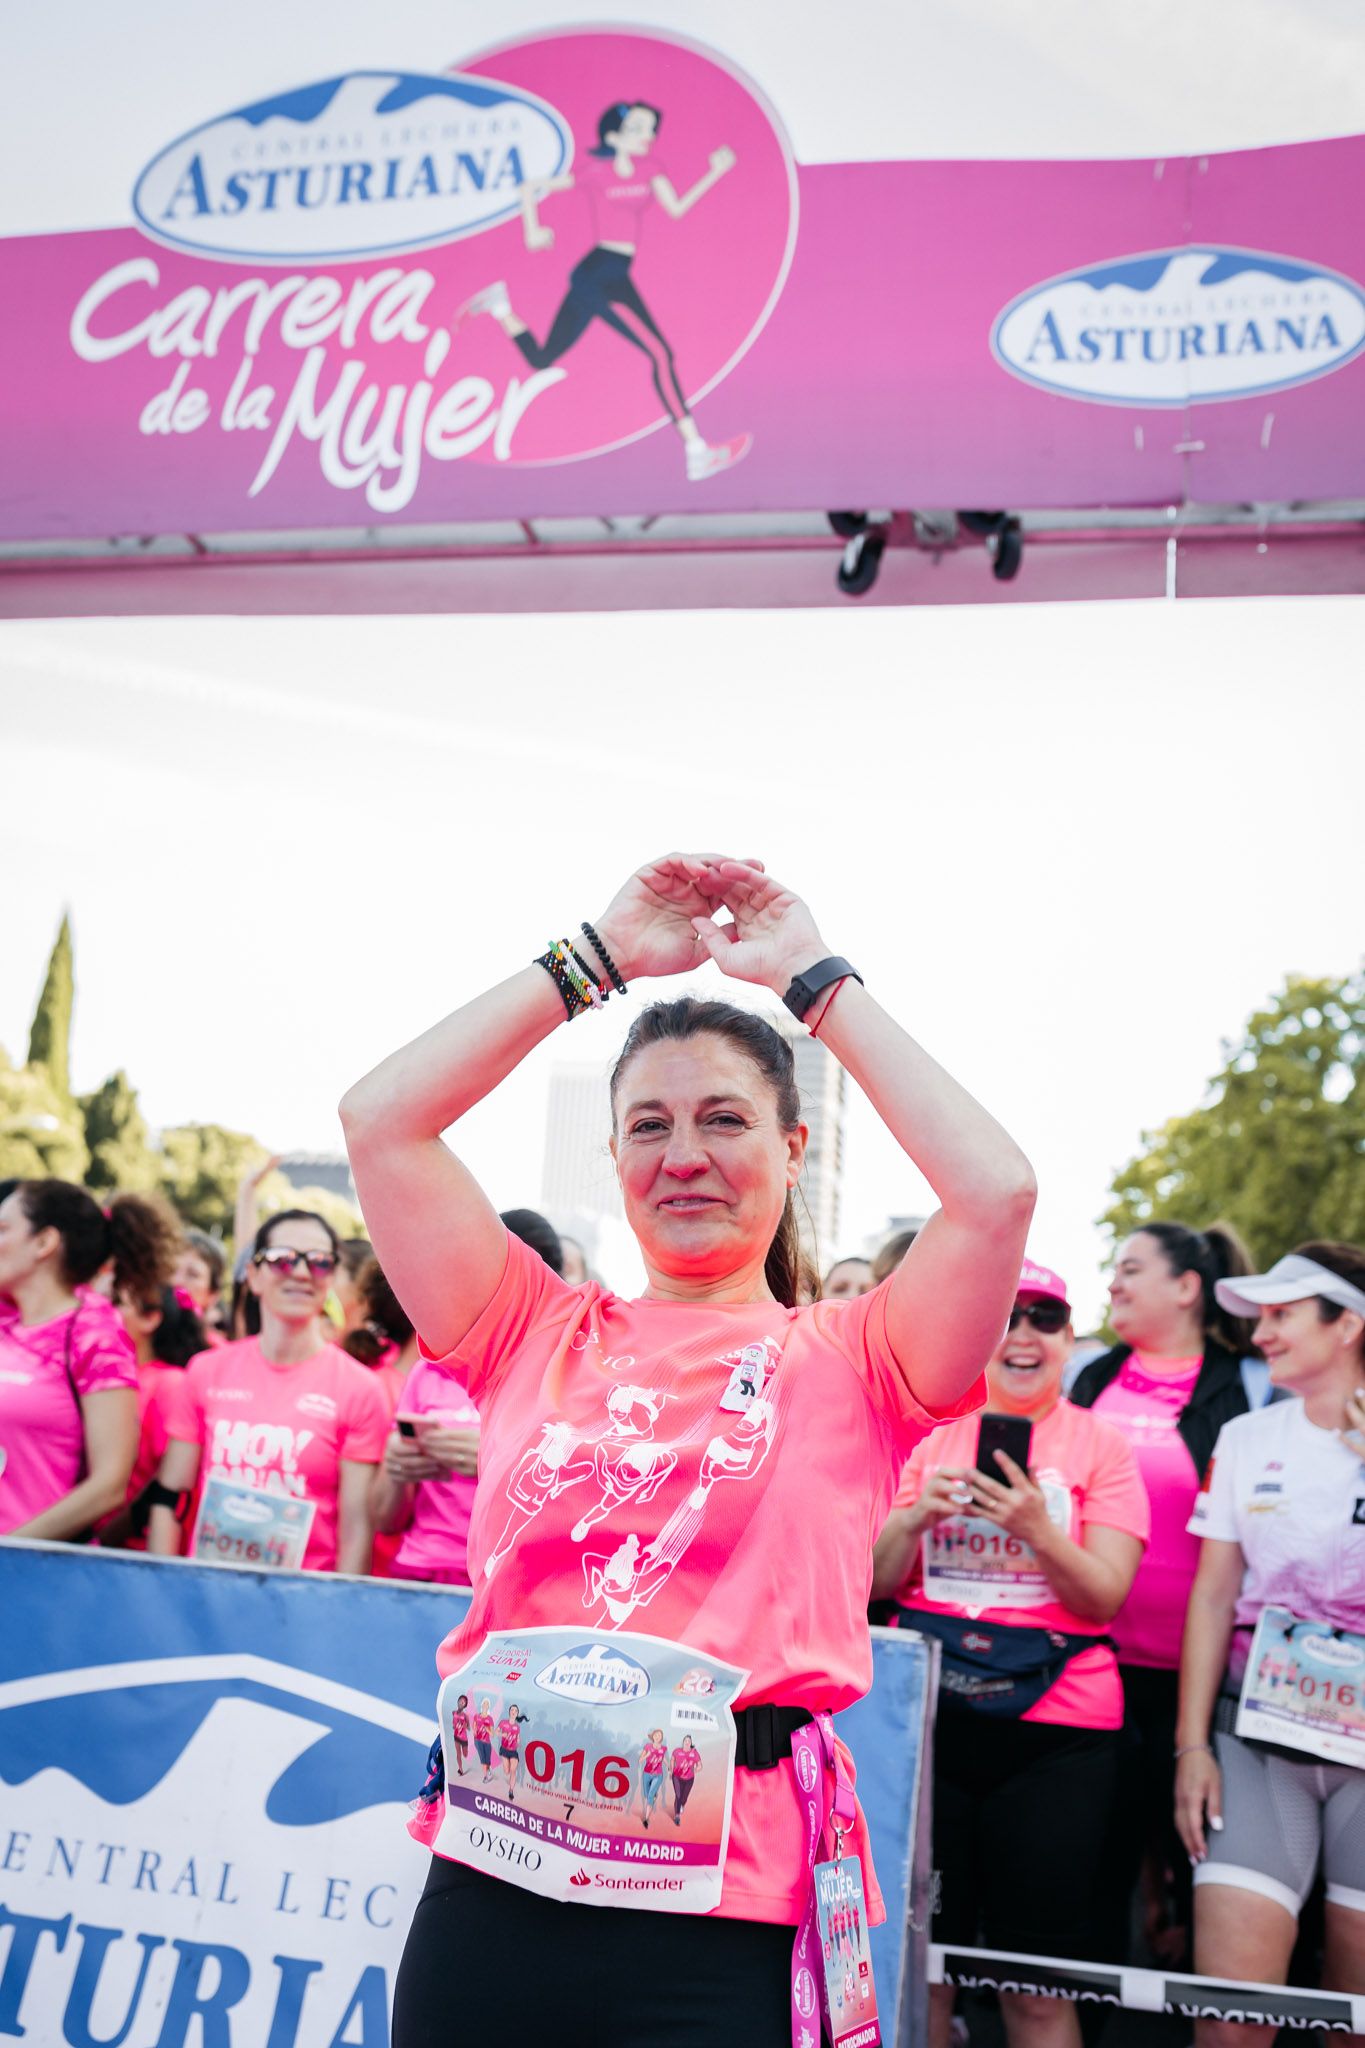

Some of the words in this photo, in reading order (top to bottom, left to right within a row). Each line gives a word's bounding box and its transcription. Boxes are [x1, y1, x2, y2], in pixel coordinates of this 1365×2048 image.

[159, 144, 528, 221] ASTURIANA
[70, 257, 435, 362] Carrera
[1025, 308, 1342, 364] ASTURIANA
[138, 359, 210, 435] de
[220, 354, 276, 432] la
[246, 329, 567, 513] Mujer
[216, 1534, 262, 1561] 016
[968, 1532, 1024, 1557] 016
[487, 1655, 528, 1668] SUMA
[541, 1665, 640, 1697] ASTURIANA
[1299, 1675, 1357, 1707] 016
[524, 1740, 631, 1799] 016
[474, 1795, 526, 1828] CARRERA
[528, 1818, 544, 1835] DE
[547, 1823, 563, 1841] LA
[566, 1830, 611, 1855] MUJER
[623, 1840, 685, 1862] MADRID
[563, 1803, 575, 1821] 7
[469, 1826, 542, 1872] OYSHO
[275, 1869, 399, 1929] LEC
[594, 1873, 686, 1892] Santander
[820, 1875, 853, 1905] MUJER
